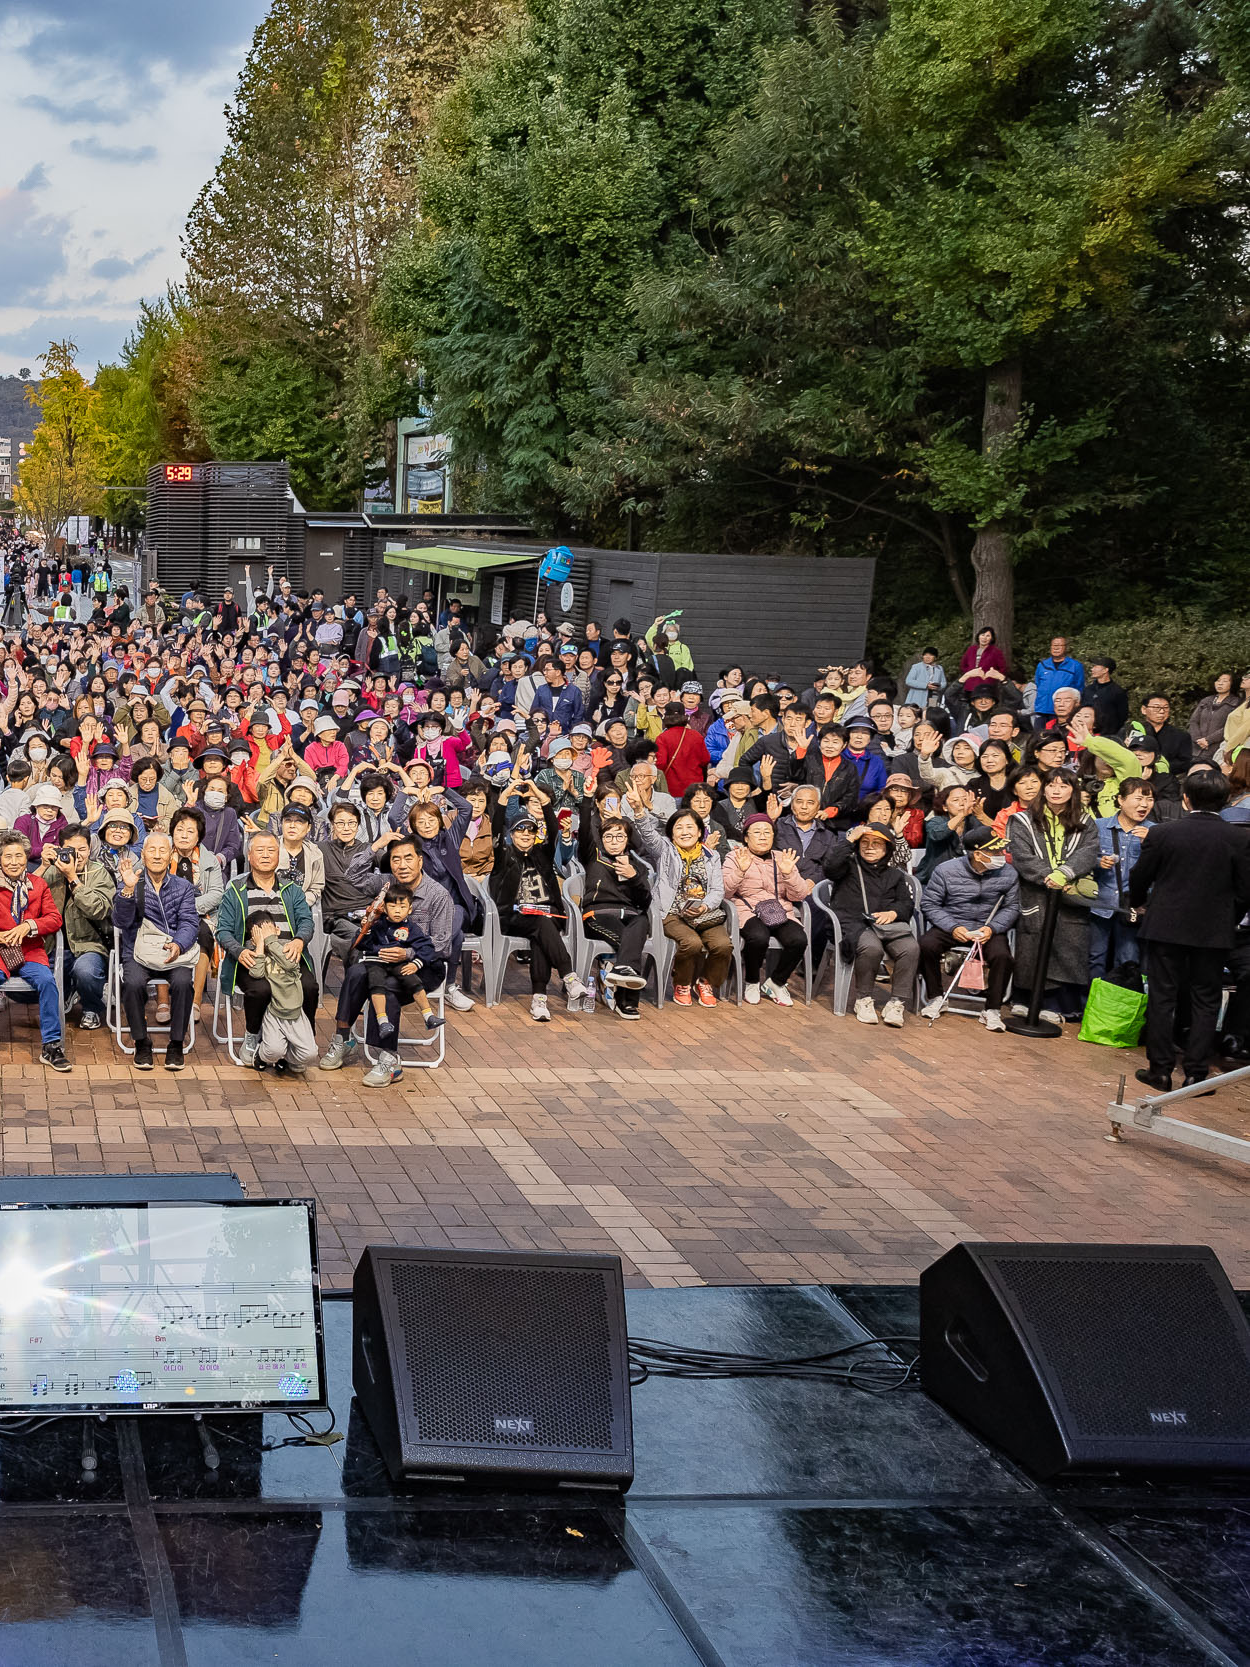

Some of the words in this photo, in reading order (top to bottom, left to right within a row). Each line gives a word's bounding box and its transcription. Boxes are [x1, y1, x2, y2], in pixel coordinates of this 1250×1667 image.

[166, 466, 192, 481] 5:29
[495, 1418, 532, 1432] NEXT
[1150, 1411, 1187, 1426] NEXT
